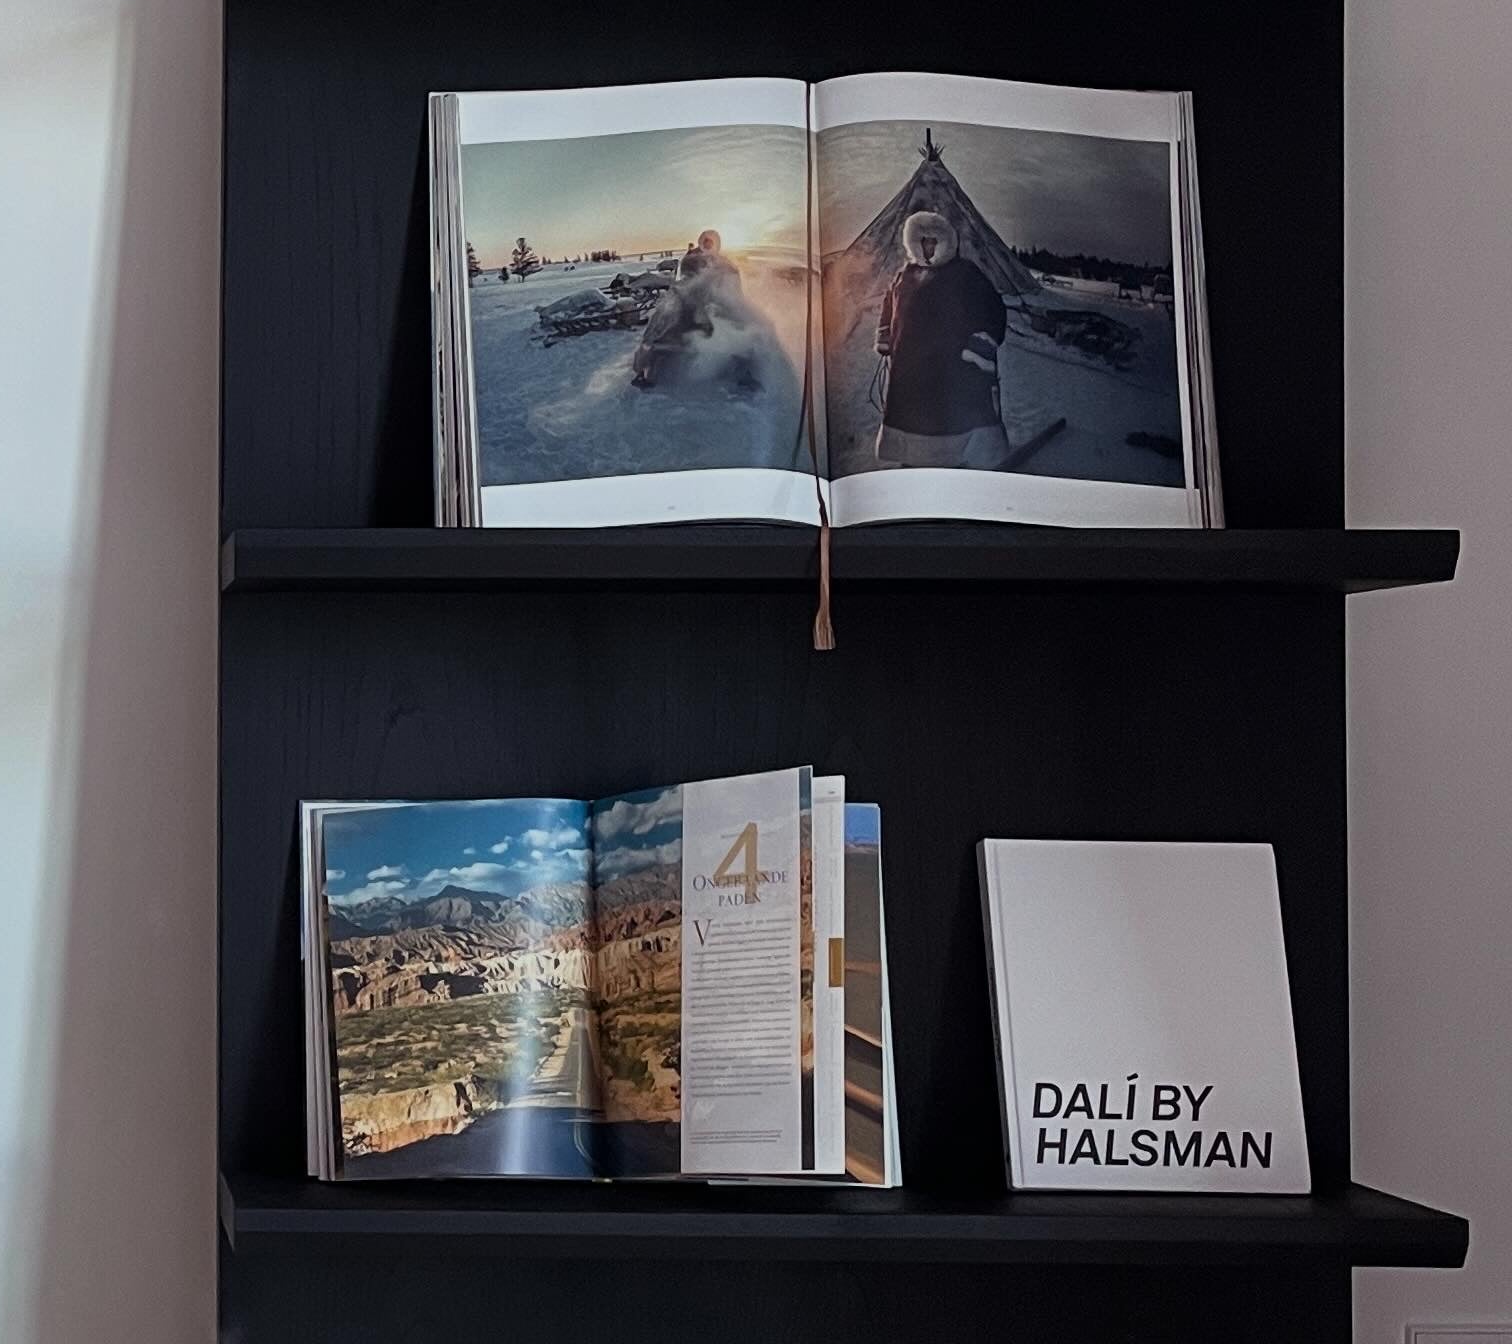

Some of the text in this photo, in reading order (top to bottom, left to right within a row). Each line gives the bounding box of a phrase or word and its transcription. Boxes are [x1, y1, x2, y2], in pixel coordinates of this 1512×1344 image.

[713, 822, 768, 905] 4
[1032, 1072, 1214, 1122] DALÍ BY
[1036, 1127, 1273, 1169] HALSMAN
